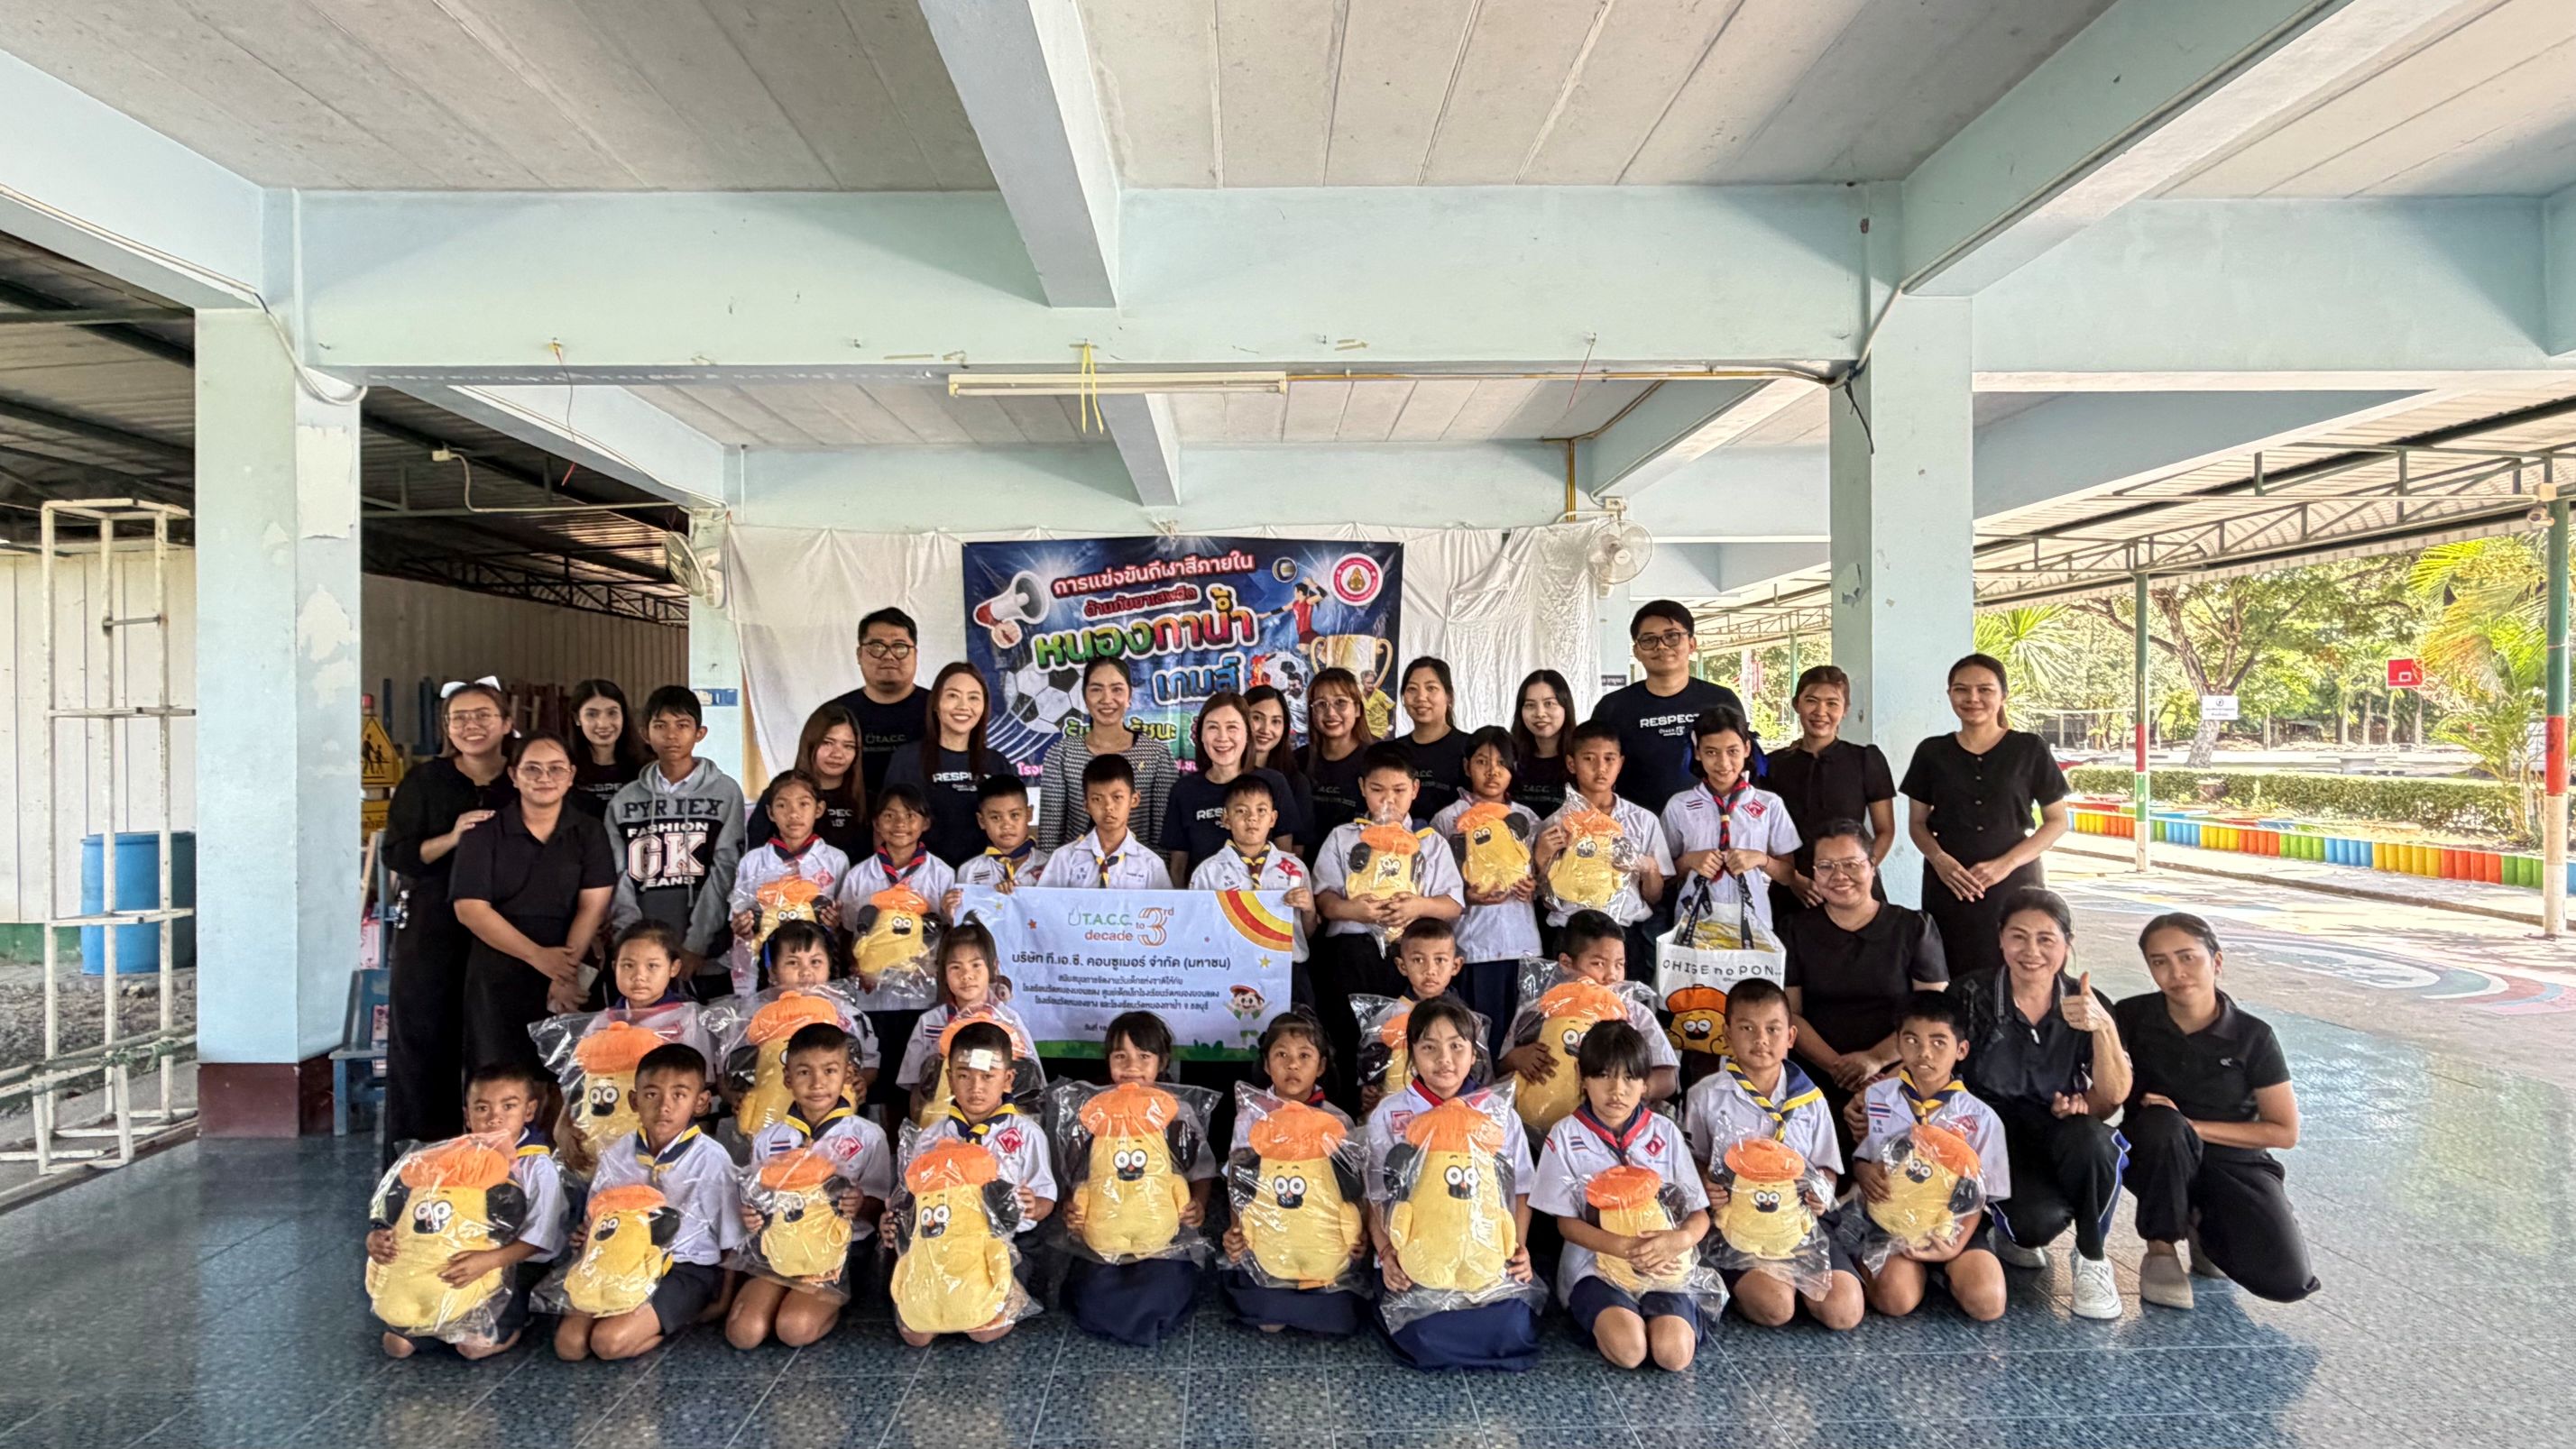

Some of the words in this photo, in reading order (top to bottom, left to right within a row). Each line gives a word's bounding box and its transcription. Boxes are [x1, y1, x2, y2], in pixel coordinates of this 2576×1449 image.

[1053, 550, 1254, 596] การแข่งขันกีฬาสีภายใน
[1084, 587, 1198, 618] ต้านภัยยาเสพติด
[1034, 588, 1256, 670] หนองกาน้ำ
[1155, 656, 1240, 700] เกมส์
[628, 822, 708, 839] FASHION
[629, 832, 706, 882] GK
[642, 876, 695, 887] EANS
[1085, 930, 1133, 941] decade
[1012, 951, 1044, 963] บริษัท
[1046, 952, 1084, 967] ที.เอ.ซี.
[1087, 955, 1145, 970] คอนซูเมอร์
[1149, 955, 1180, 967] จำกัด
[1183, 957, 1231, 971] (มหาชน)
